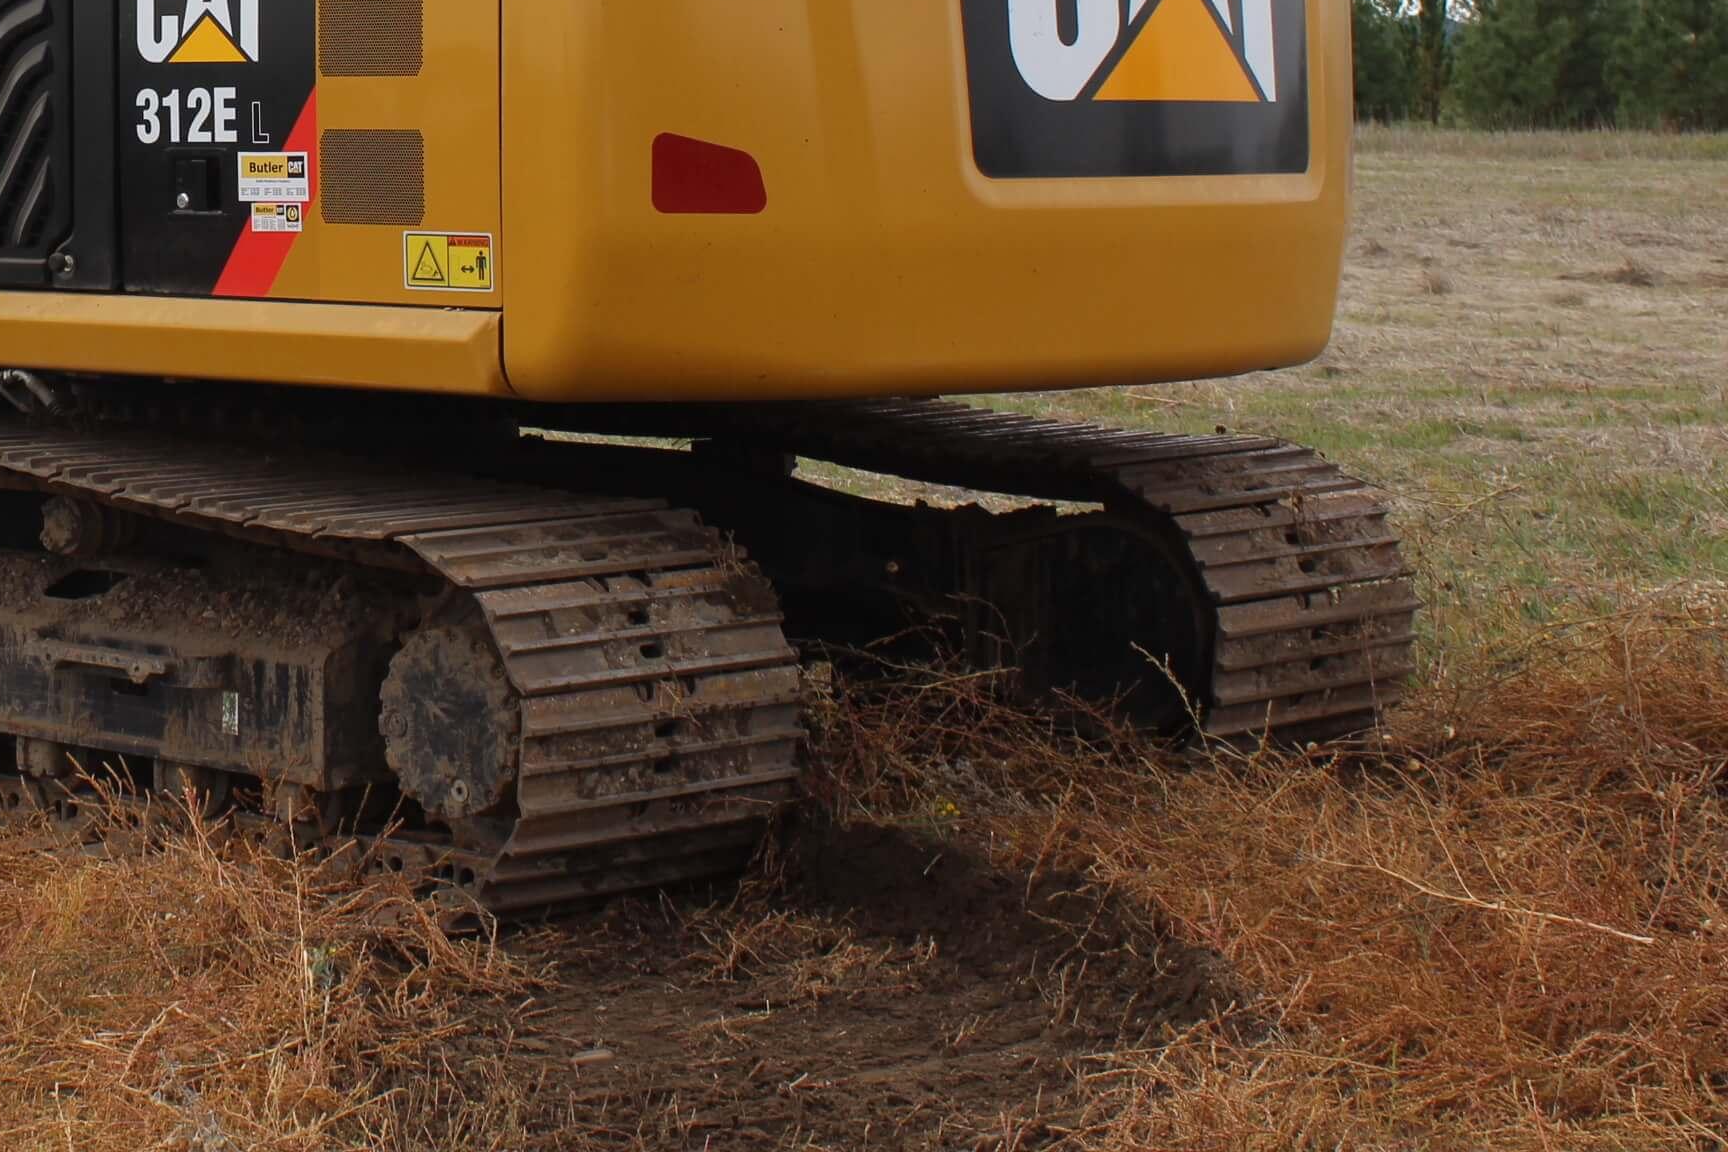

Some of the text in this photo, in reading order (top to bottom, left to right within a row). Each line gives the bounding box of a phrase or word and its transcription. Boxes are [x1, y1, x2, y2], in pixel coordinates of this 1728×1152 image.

[135, 87, 270, 144] 312E L
[249, 160, 304, 173] Butler CAT
